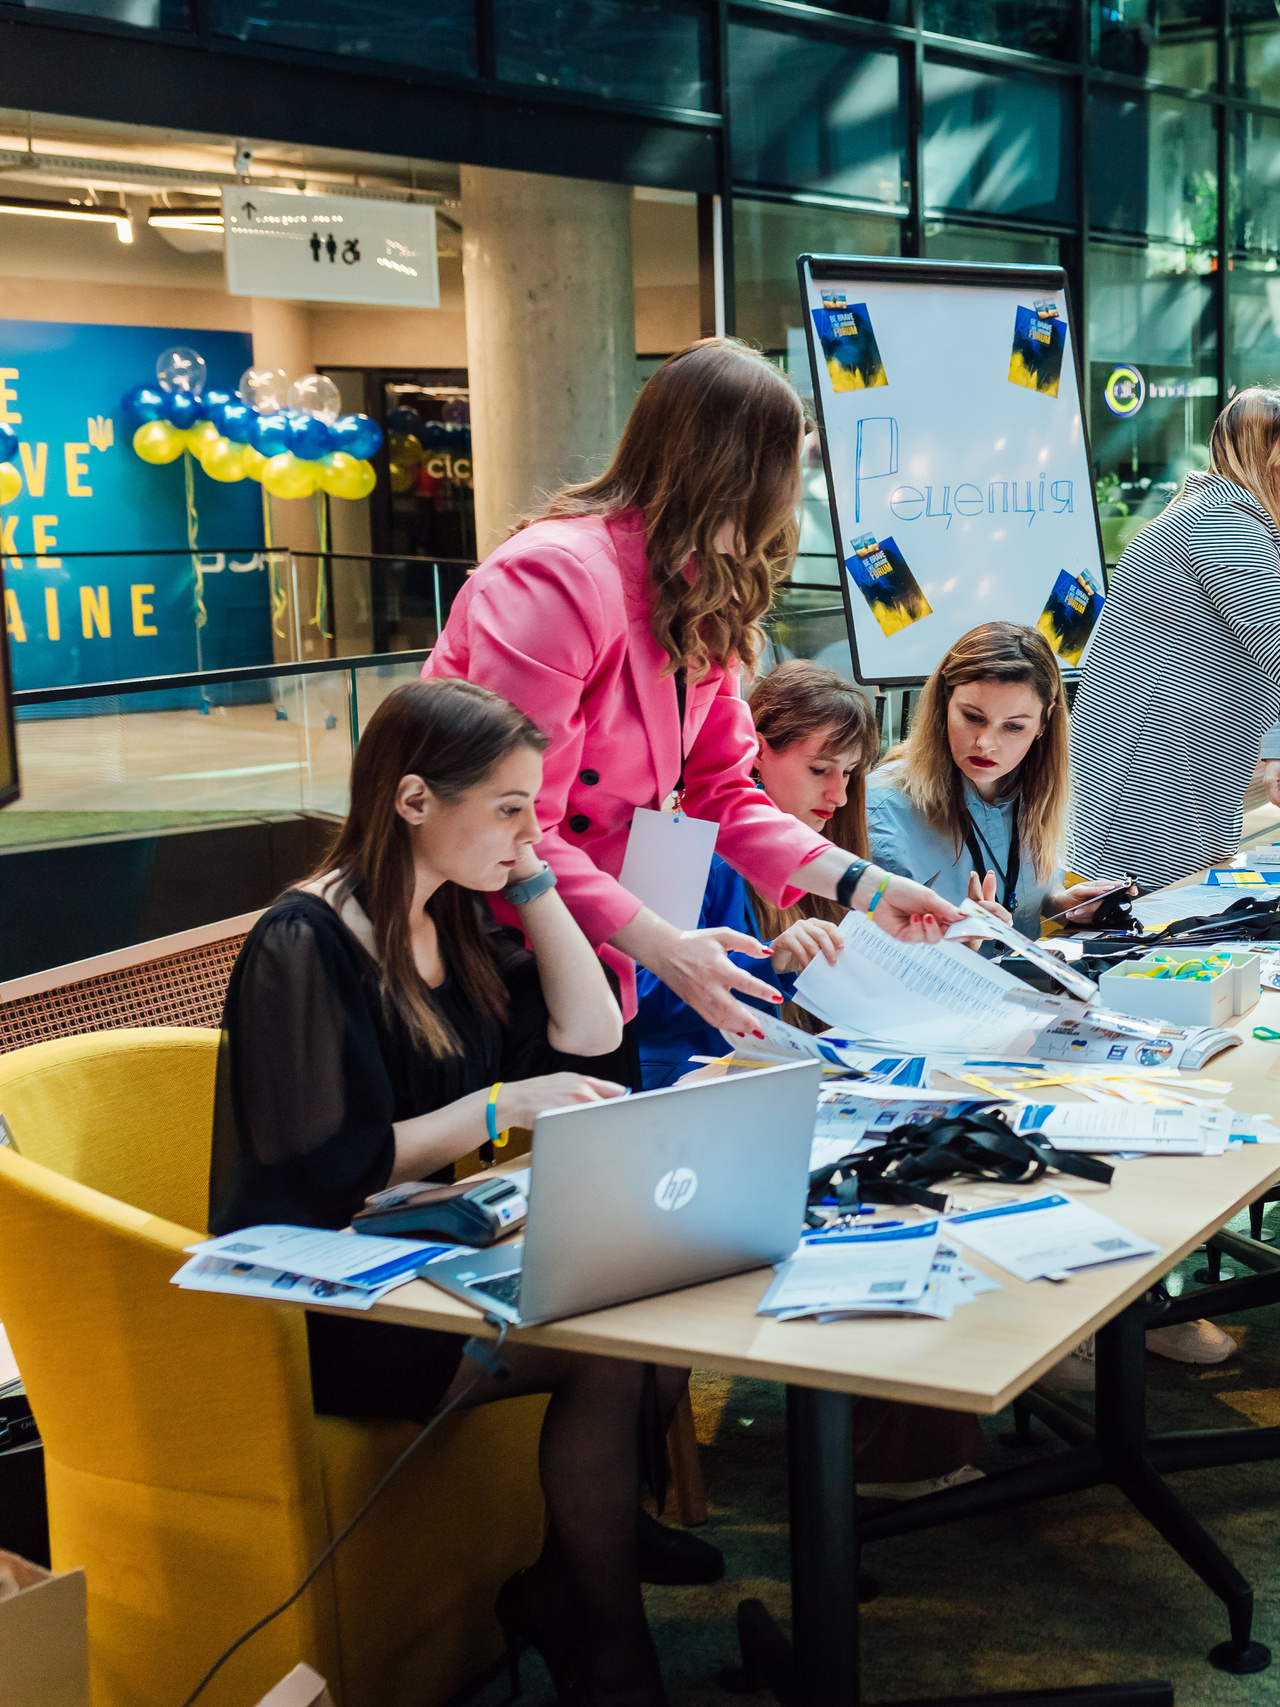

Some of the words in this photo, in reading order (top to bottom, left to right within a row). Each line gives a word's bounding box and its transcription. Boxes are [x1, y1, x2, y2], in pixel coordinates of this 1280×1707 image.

[855, 416, 1074, 530] Рецепція
[869, 562, 893, 580] FORUM
[660, 1168, 693, 1212] hp
